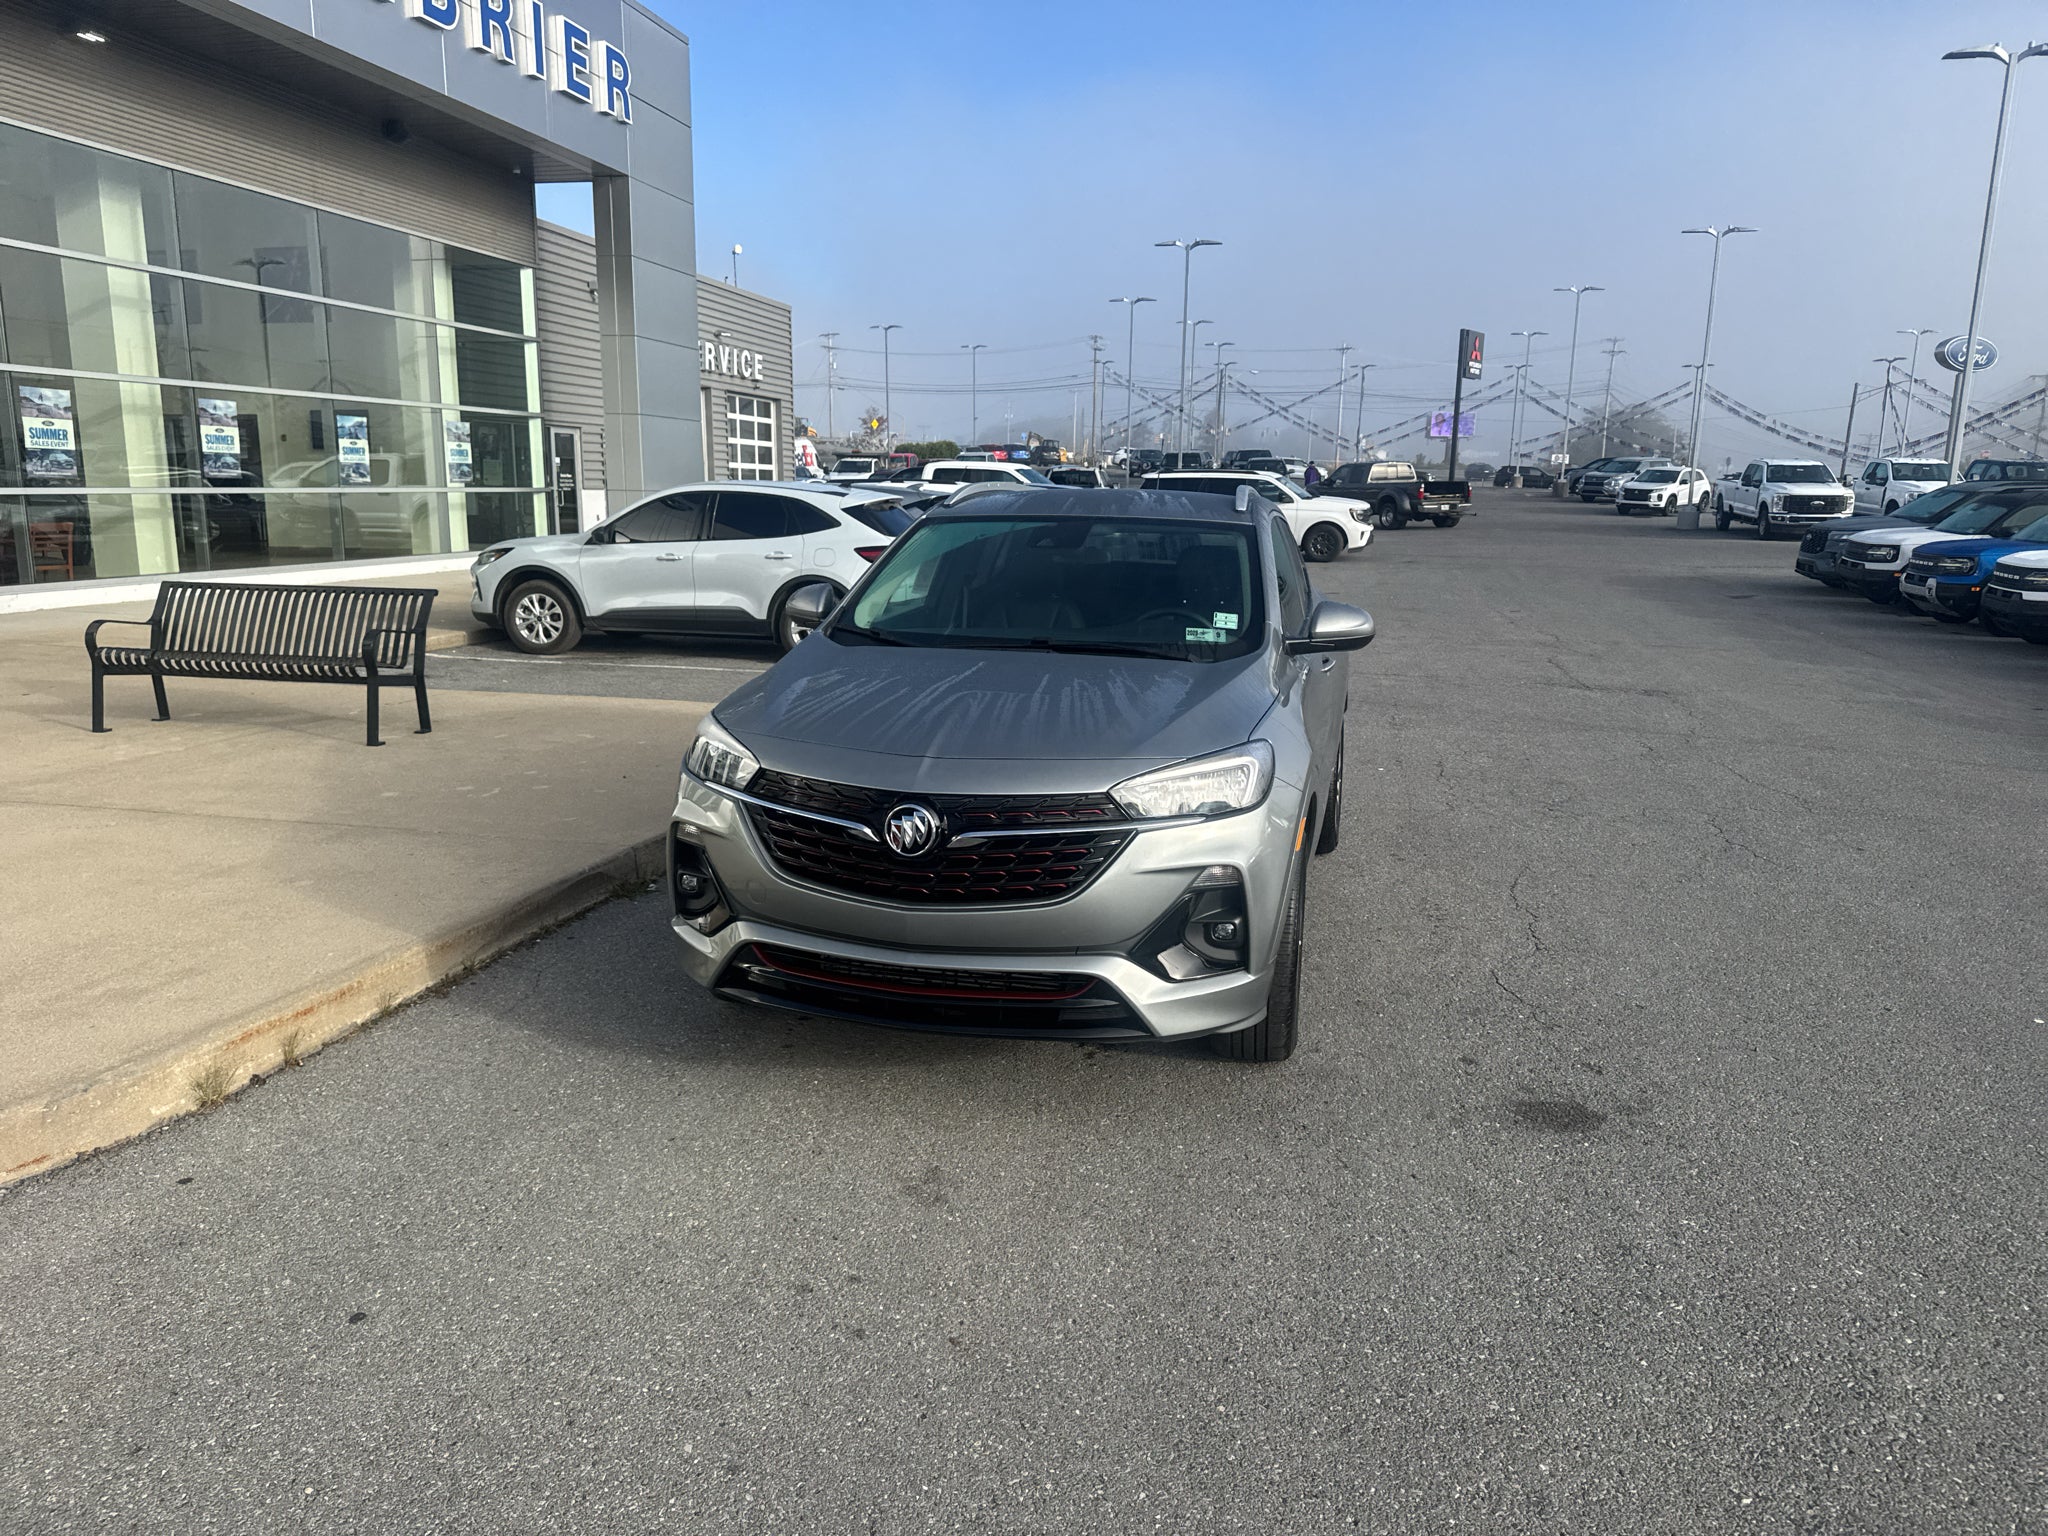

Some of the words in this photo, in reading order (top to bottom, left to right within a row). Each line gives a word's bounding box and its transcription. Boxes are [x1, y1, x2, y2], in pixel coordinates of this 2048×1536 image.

[697, 340, 764, 380] RVICE
[28, 426, 69, 441] SUMMER
[204, 433, 235, 446] SUMMER
[50, 440, 69, 448] EVENT
